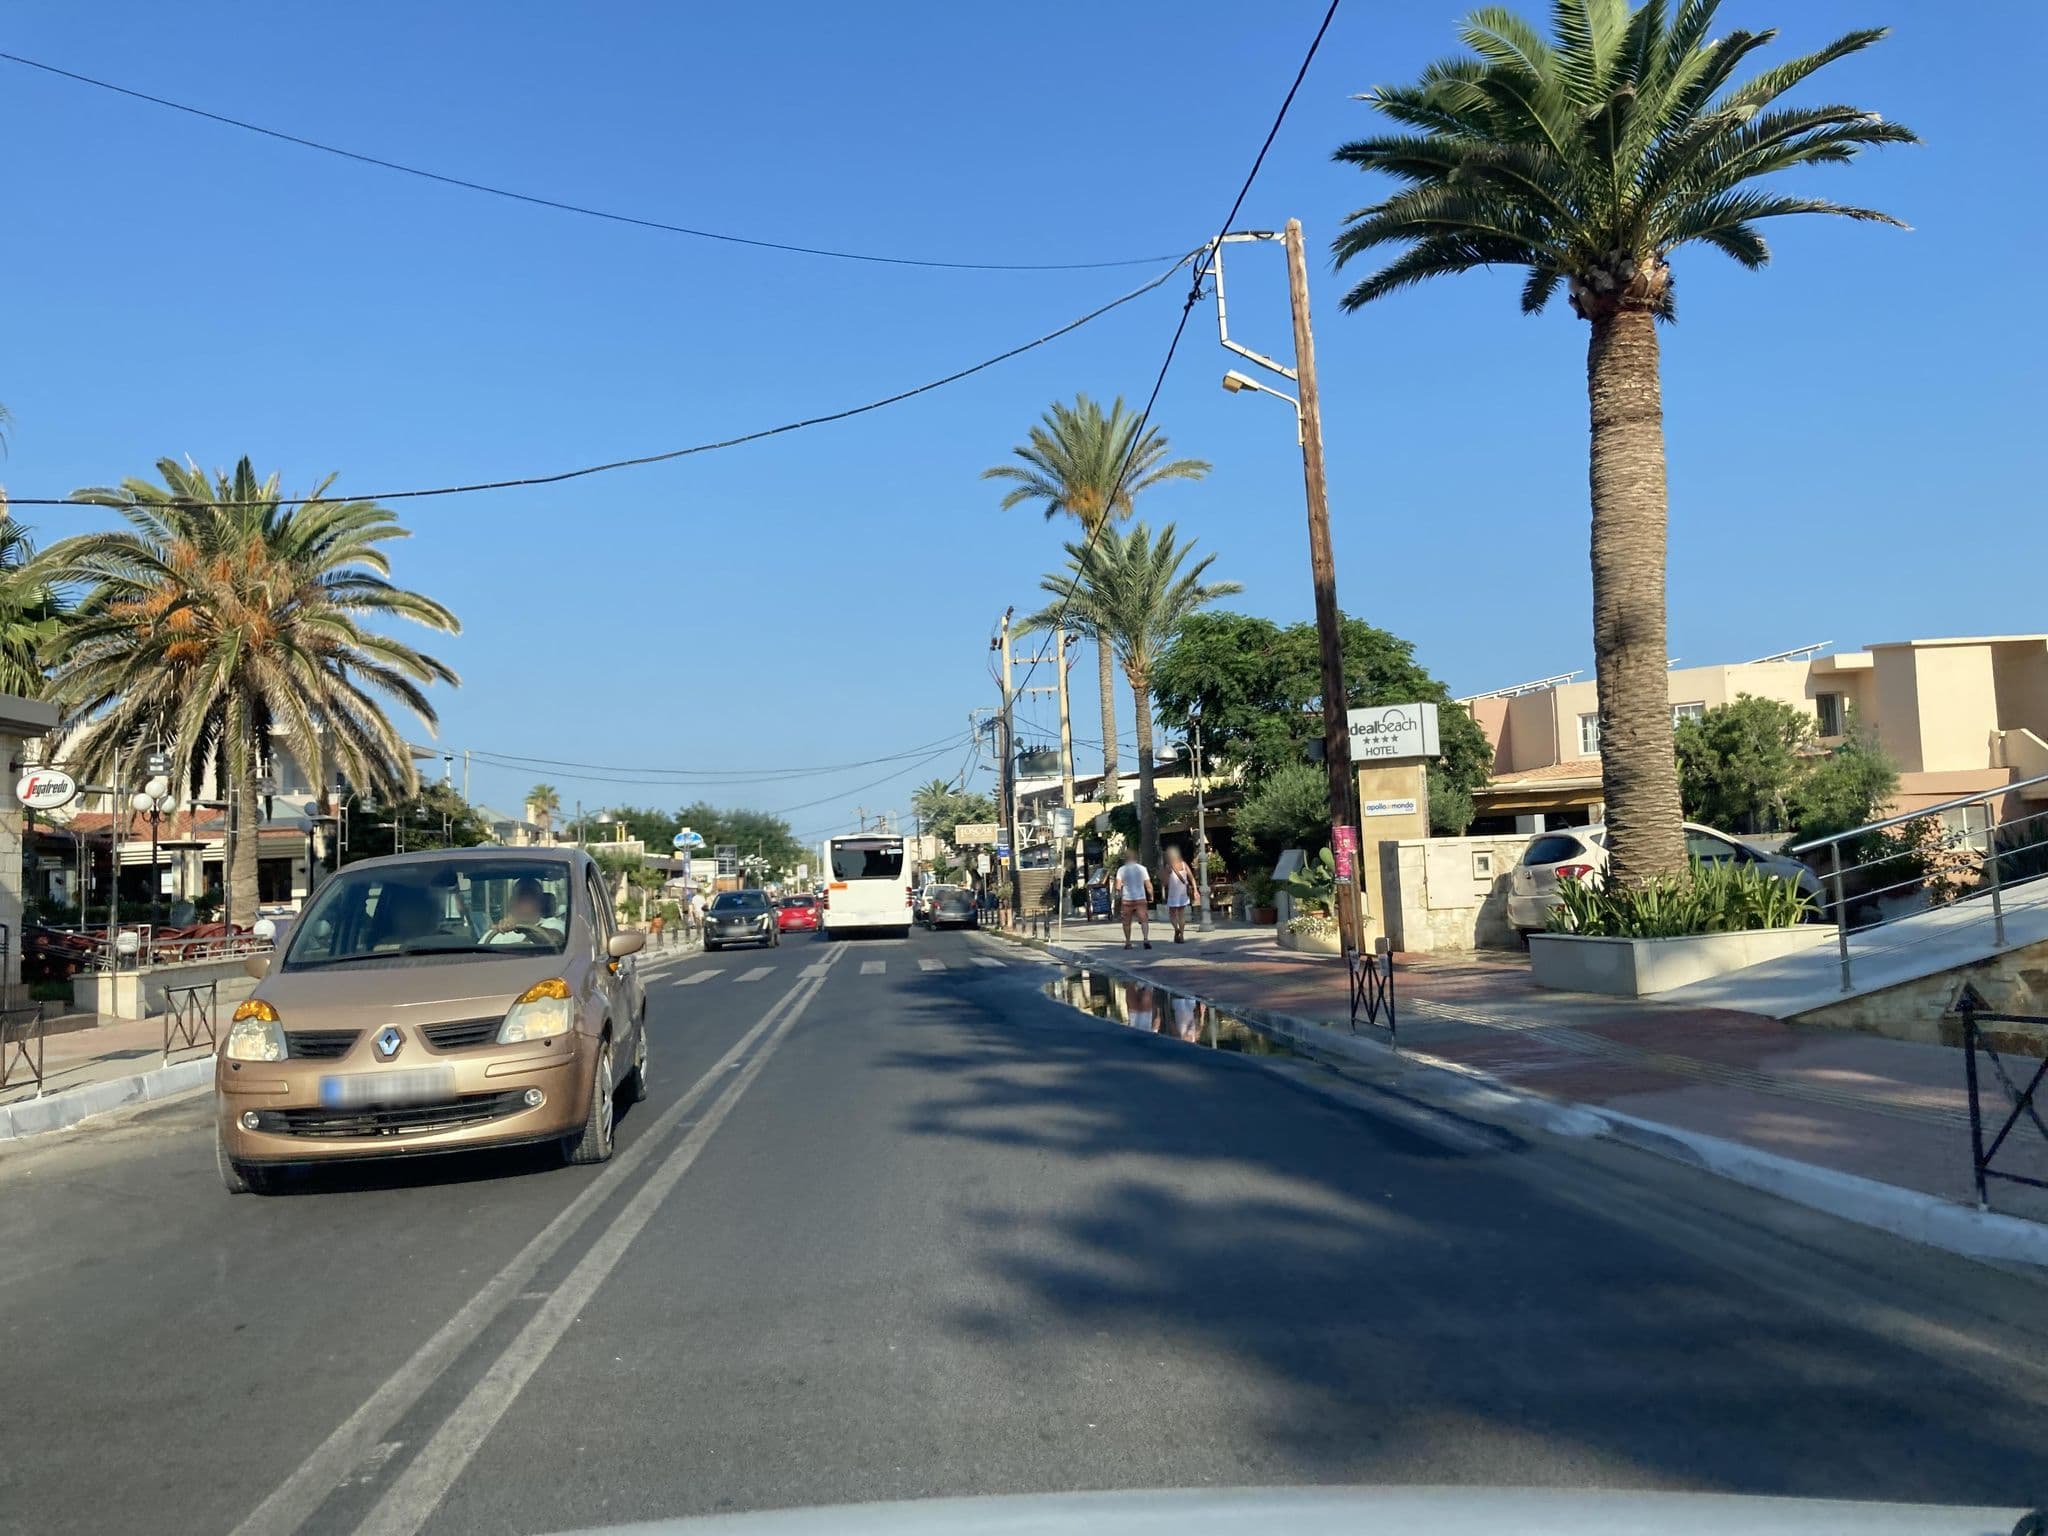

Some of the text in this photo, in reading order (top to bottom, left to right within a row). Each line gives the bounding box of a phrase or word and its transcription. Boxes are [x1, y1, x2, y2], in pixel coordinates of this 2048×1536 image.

[1350, 718, 1417, 736] dealbeach
[1366, 746, 1398, 756] HOTEL
[23, 777, 68, 799] Segafredo
